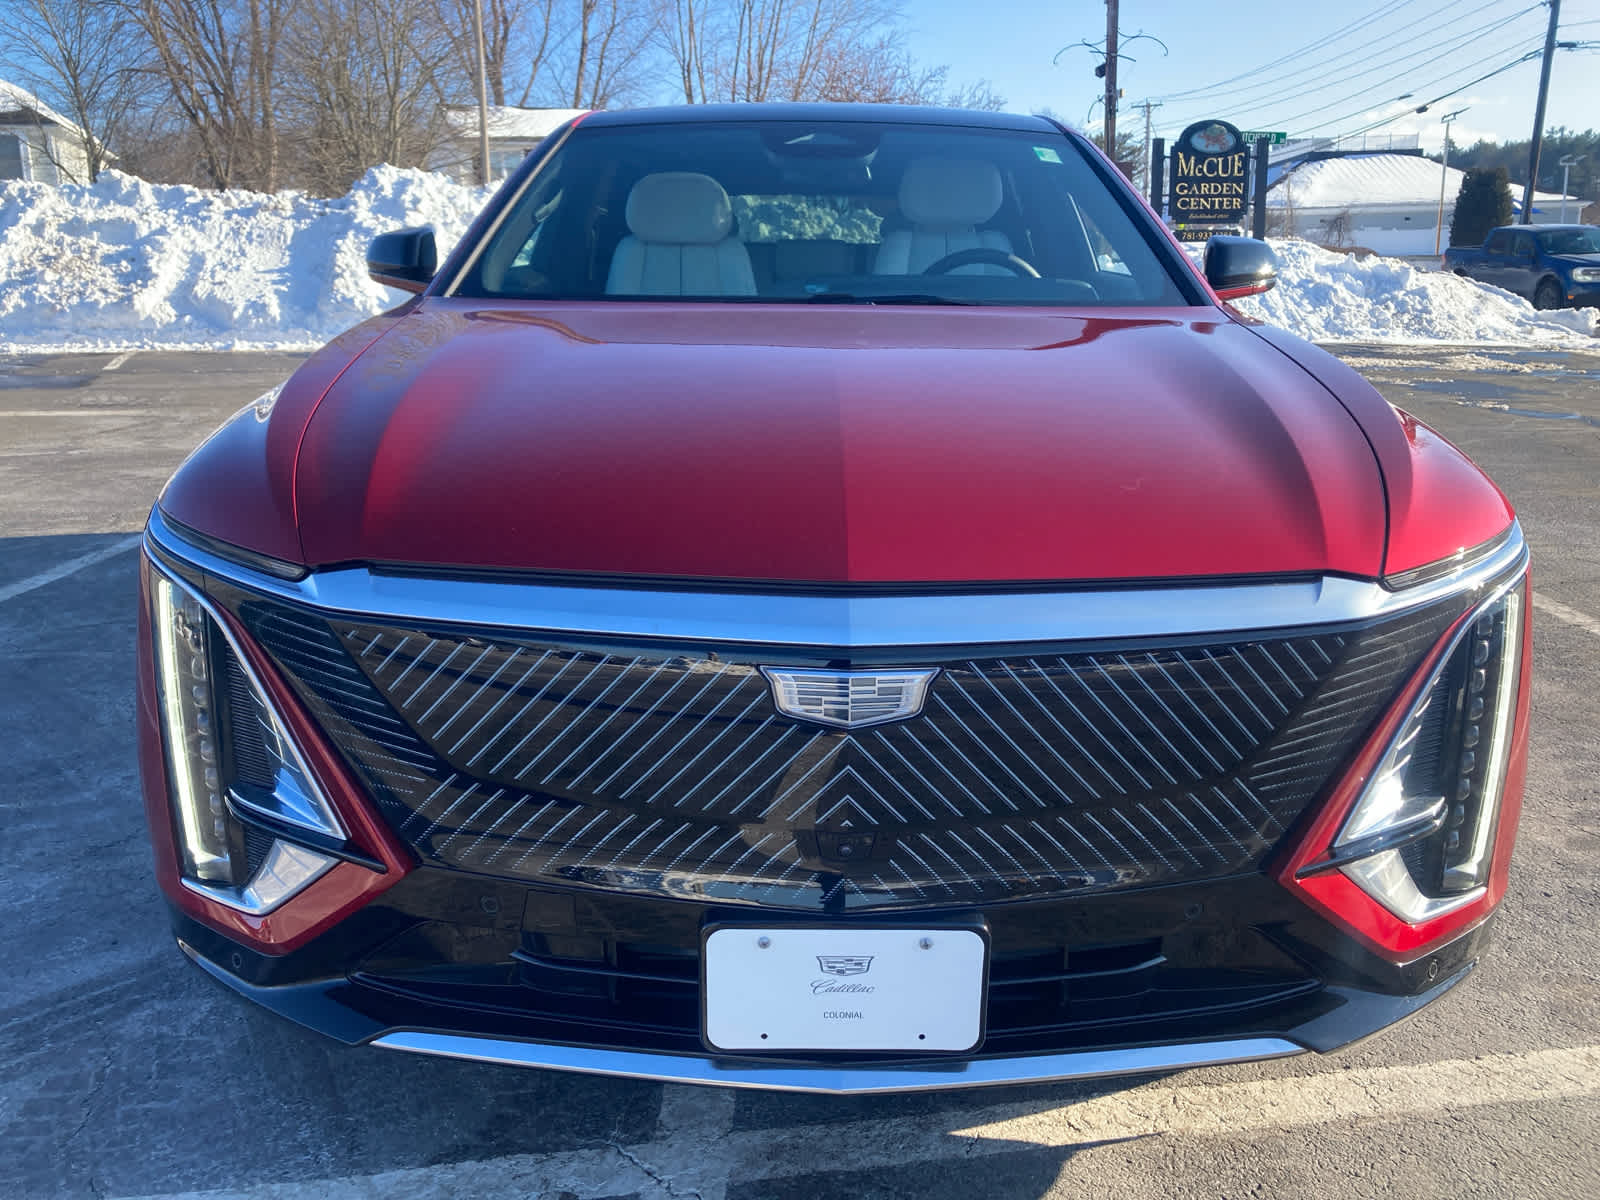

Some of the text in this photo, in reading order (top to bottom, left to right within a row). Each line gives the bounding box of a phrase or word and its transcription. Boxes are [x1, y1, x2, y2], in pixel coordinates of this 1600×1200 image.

[1177, 152, 1245, 177] McCUE
[1175, 182, 1244, 195] GARDEN
[1176, 197, 1241, 210] CENTER
[810, 979, 875, 995] Cadillac
[823, 1011, 864, 1019] COLONIAL
